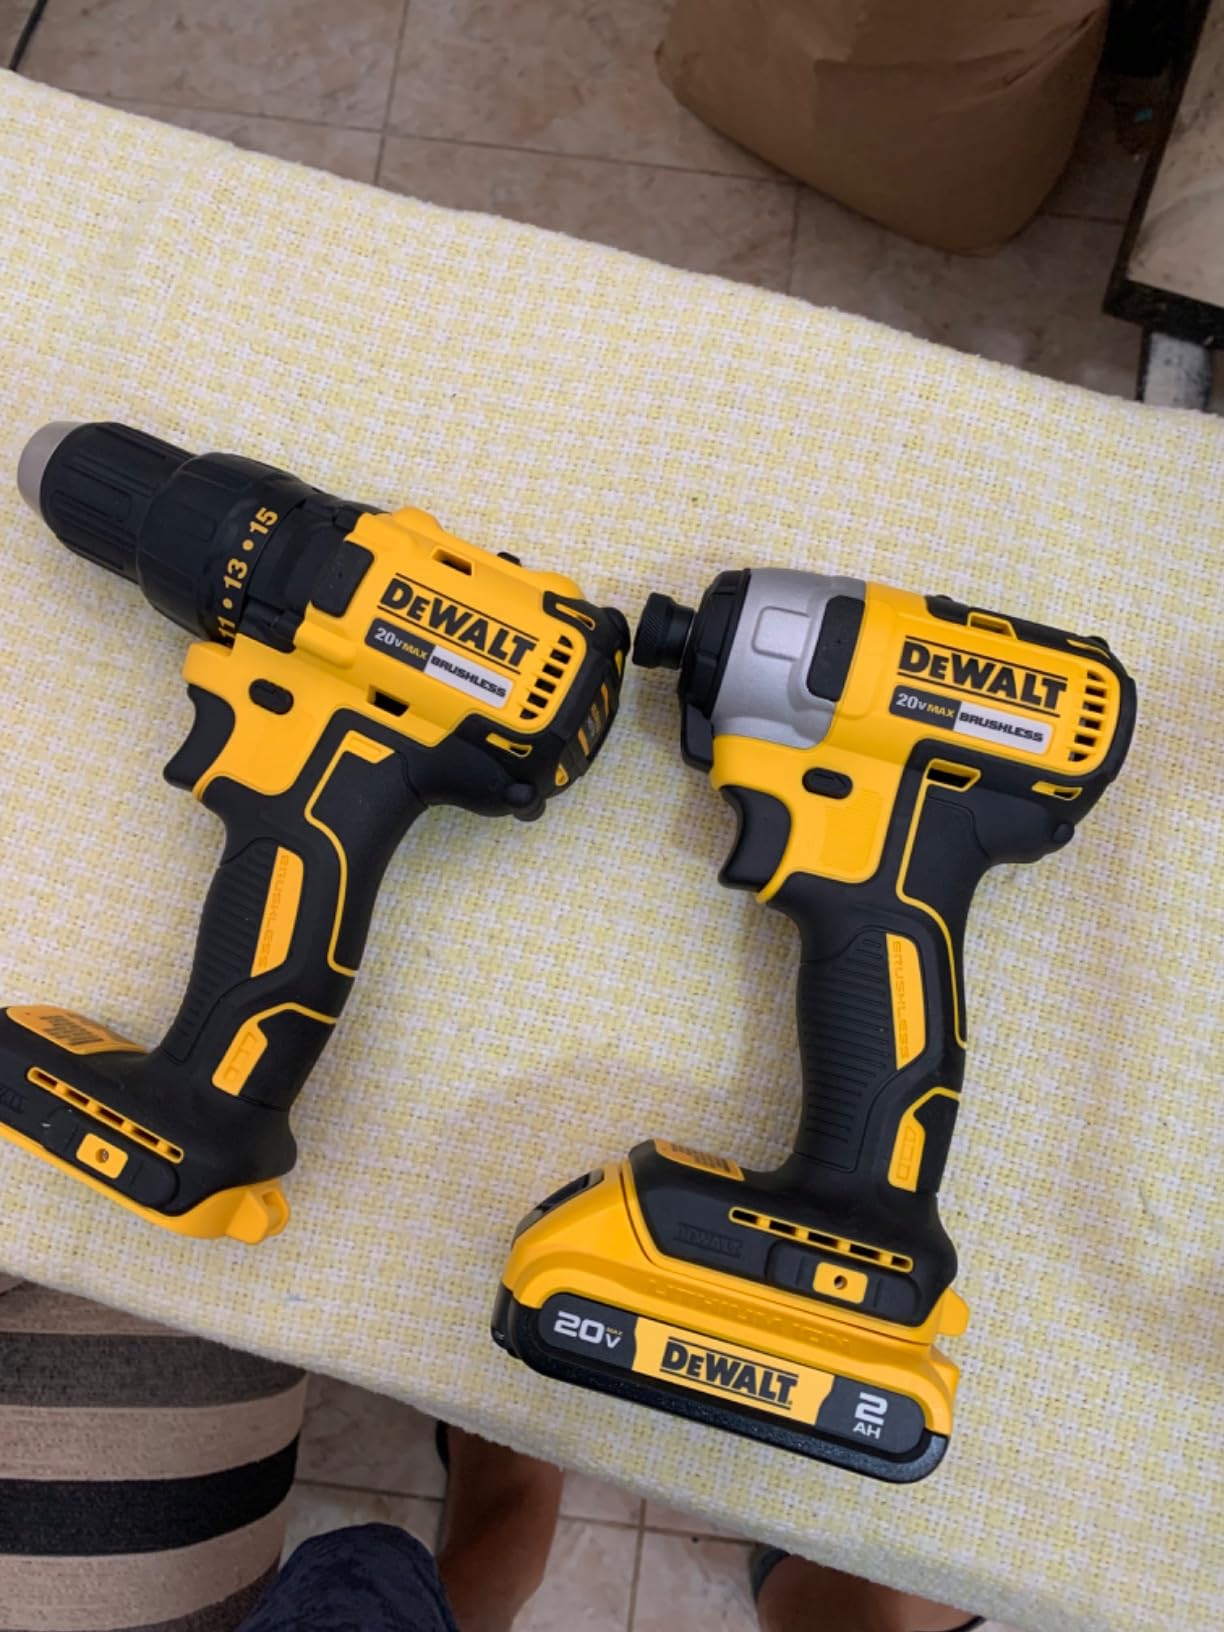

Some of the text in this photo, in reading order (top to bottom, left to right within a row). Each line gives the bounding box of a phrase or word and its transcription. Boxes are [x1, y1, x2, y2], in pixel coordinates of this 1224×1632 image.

[249, 507, 278, 535] 15
[224, 558, 248, 589] 13
[380, 577, 537, 667] DEWALT
[430, 655, 506, 698] BRUSHLESS
[898, 640, 1067, 710] DEWALT
[959, 712, 1043, 743] BRUSHLESS
[660, 1340, 798, 1405] DEWALT
[854, 1391, 888, 1426] 2
[853, 1423, 881, 1439] AH
